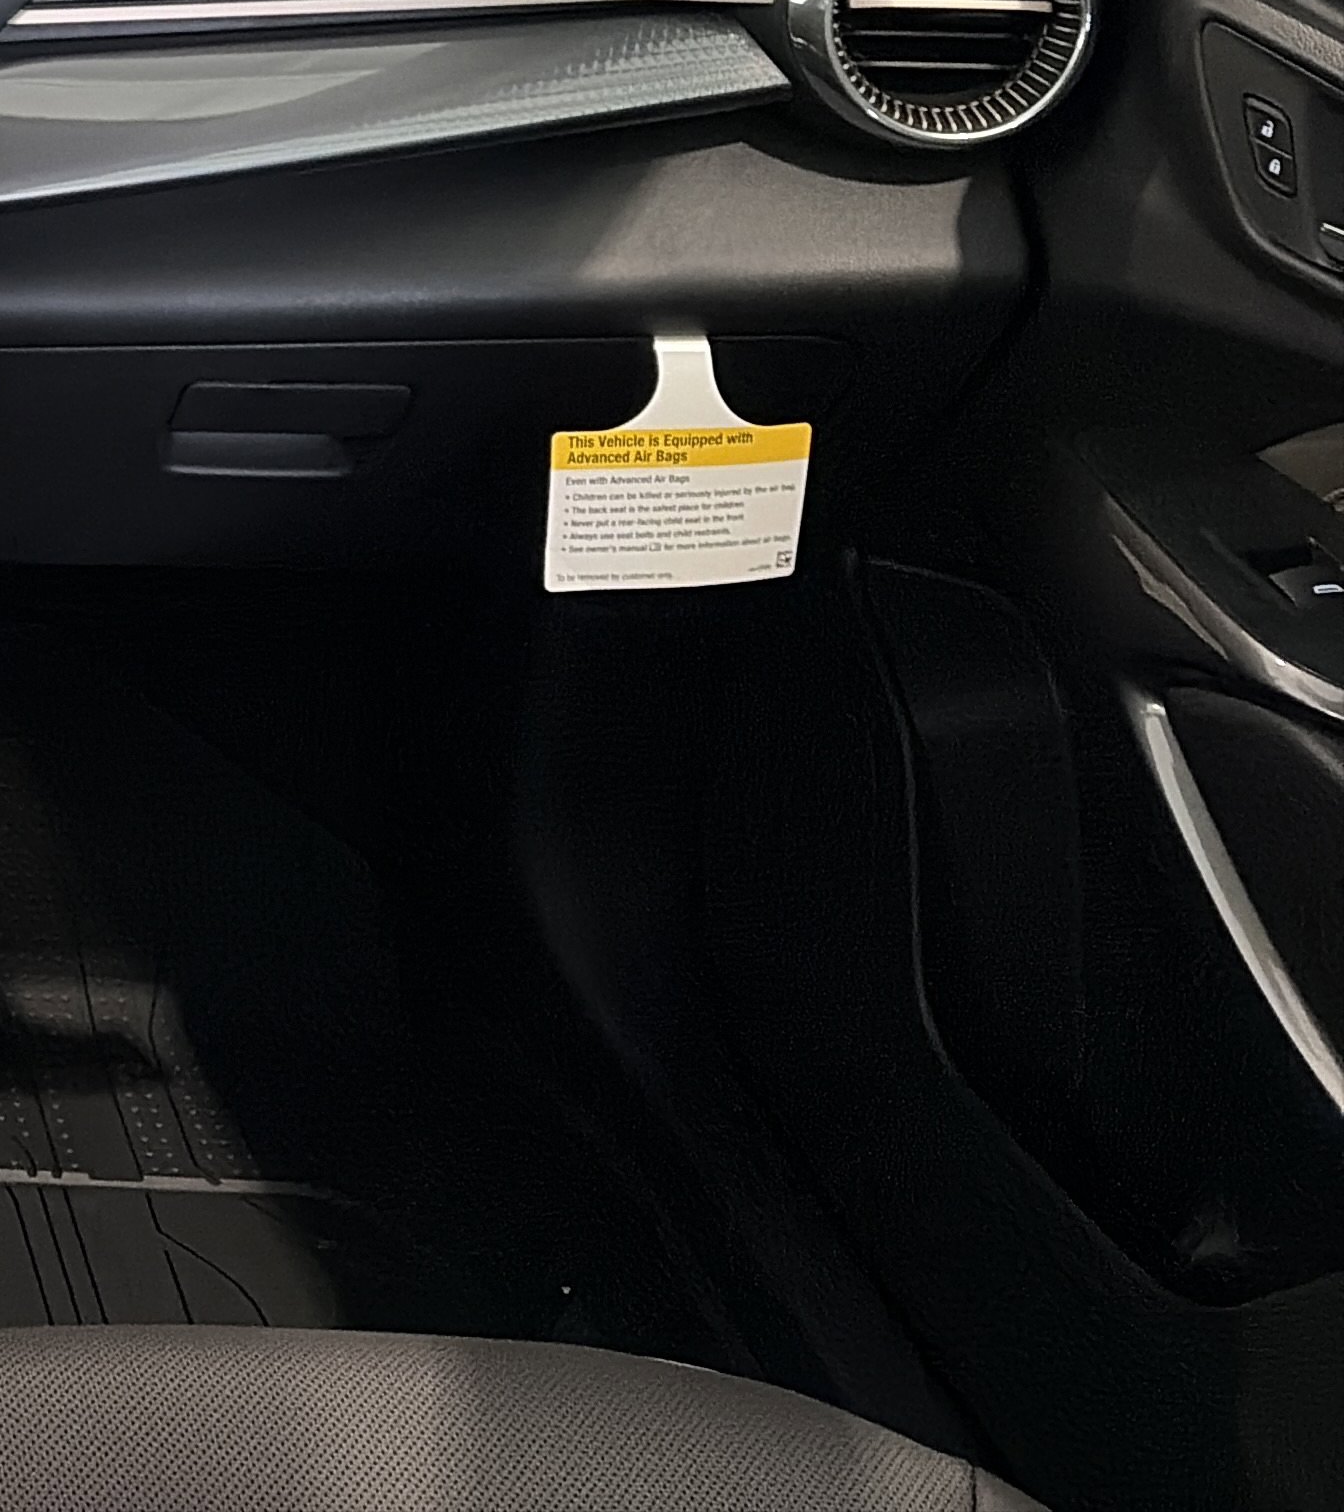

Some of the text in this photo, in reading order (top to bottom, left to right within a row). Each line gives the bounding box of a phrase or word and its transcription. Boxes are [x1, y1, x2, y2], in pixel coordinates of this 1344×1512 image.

[568, 431, 754, 449] This Vehicle is Equipped with
[567, 449, 688, 464] Advanced Air Bags
[566, 474, 690, 486] Even with Advanced Air Bags
[573, 492, 607, 501] Children
[609, 493, 624, 501] can
[627, 492, 636, 501] be
[639, 490, 662, 499] killed
[573, 506, 586, 514] The
[589, 505, 607, 513] back
[571, 519, 593, 527] Never
